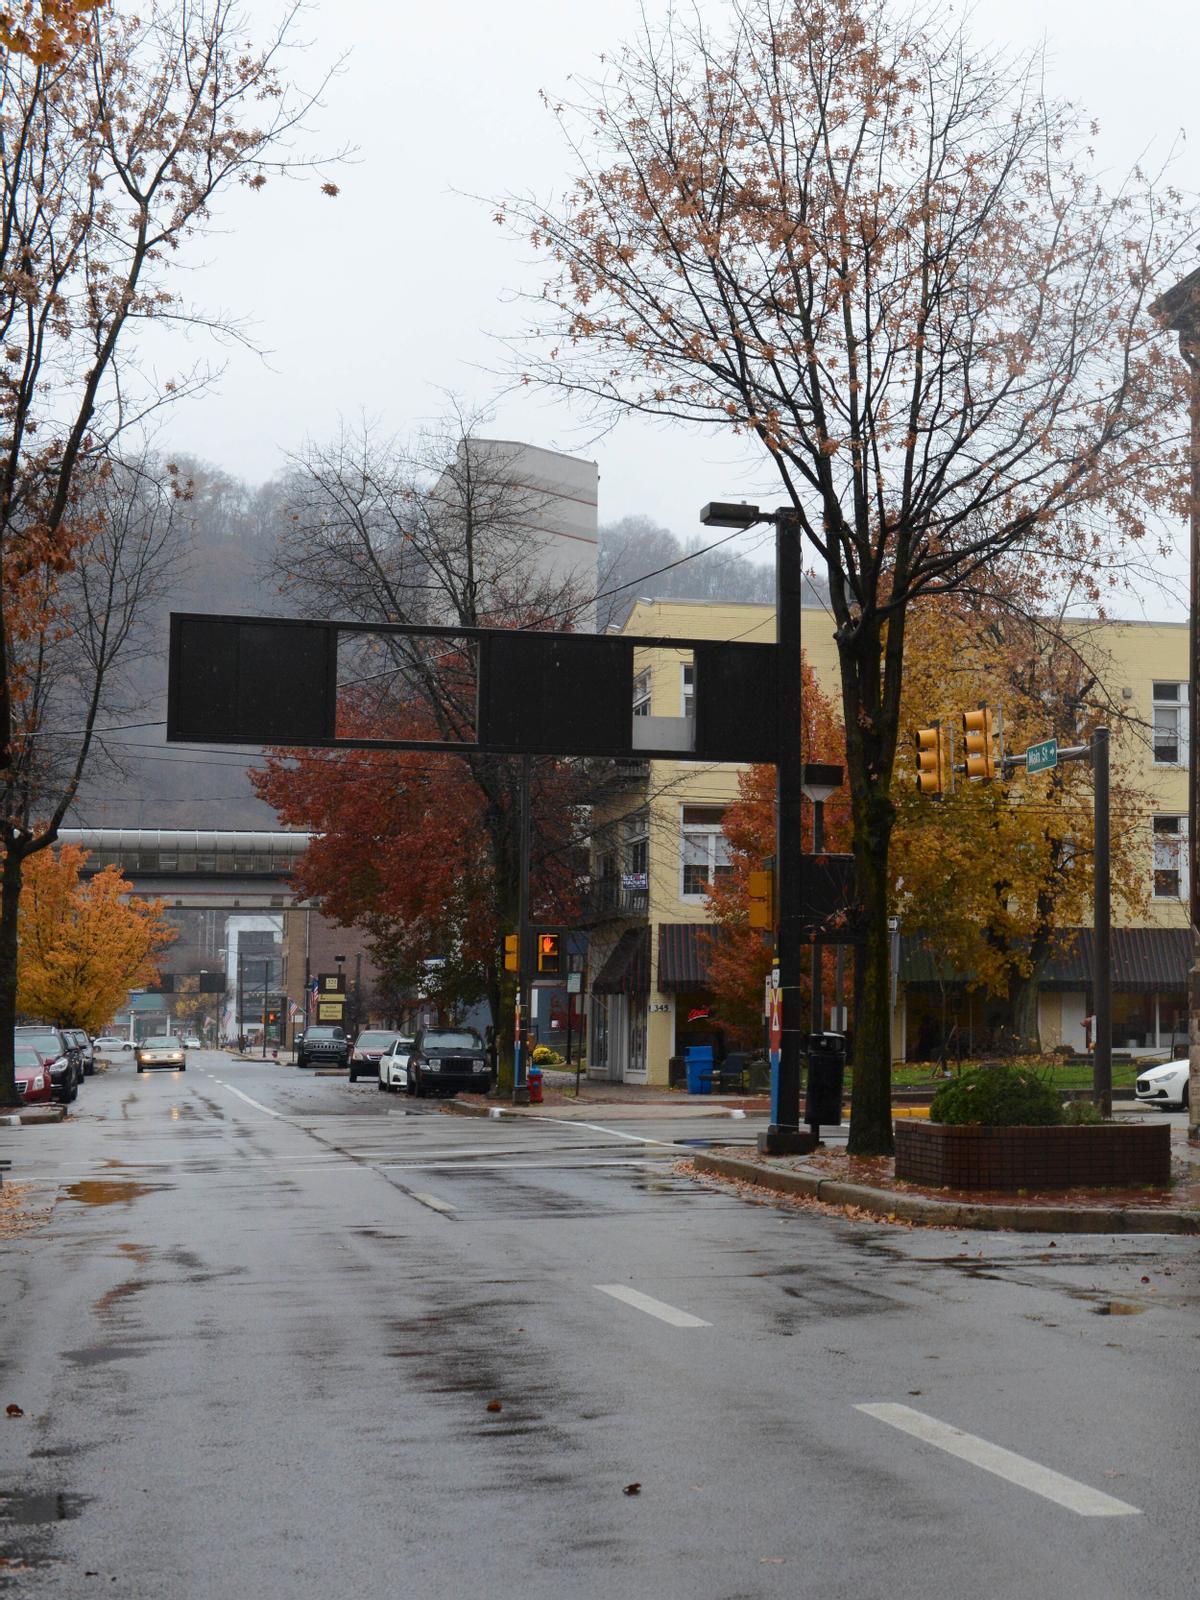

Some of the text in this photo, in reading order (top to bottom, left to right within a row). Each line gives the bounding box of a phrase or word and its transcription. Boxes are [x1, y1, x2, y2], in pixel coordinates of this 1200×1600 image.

[1028, 746, 1049, 766] Main St
[654, 1004, 669, 1012] 345
